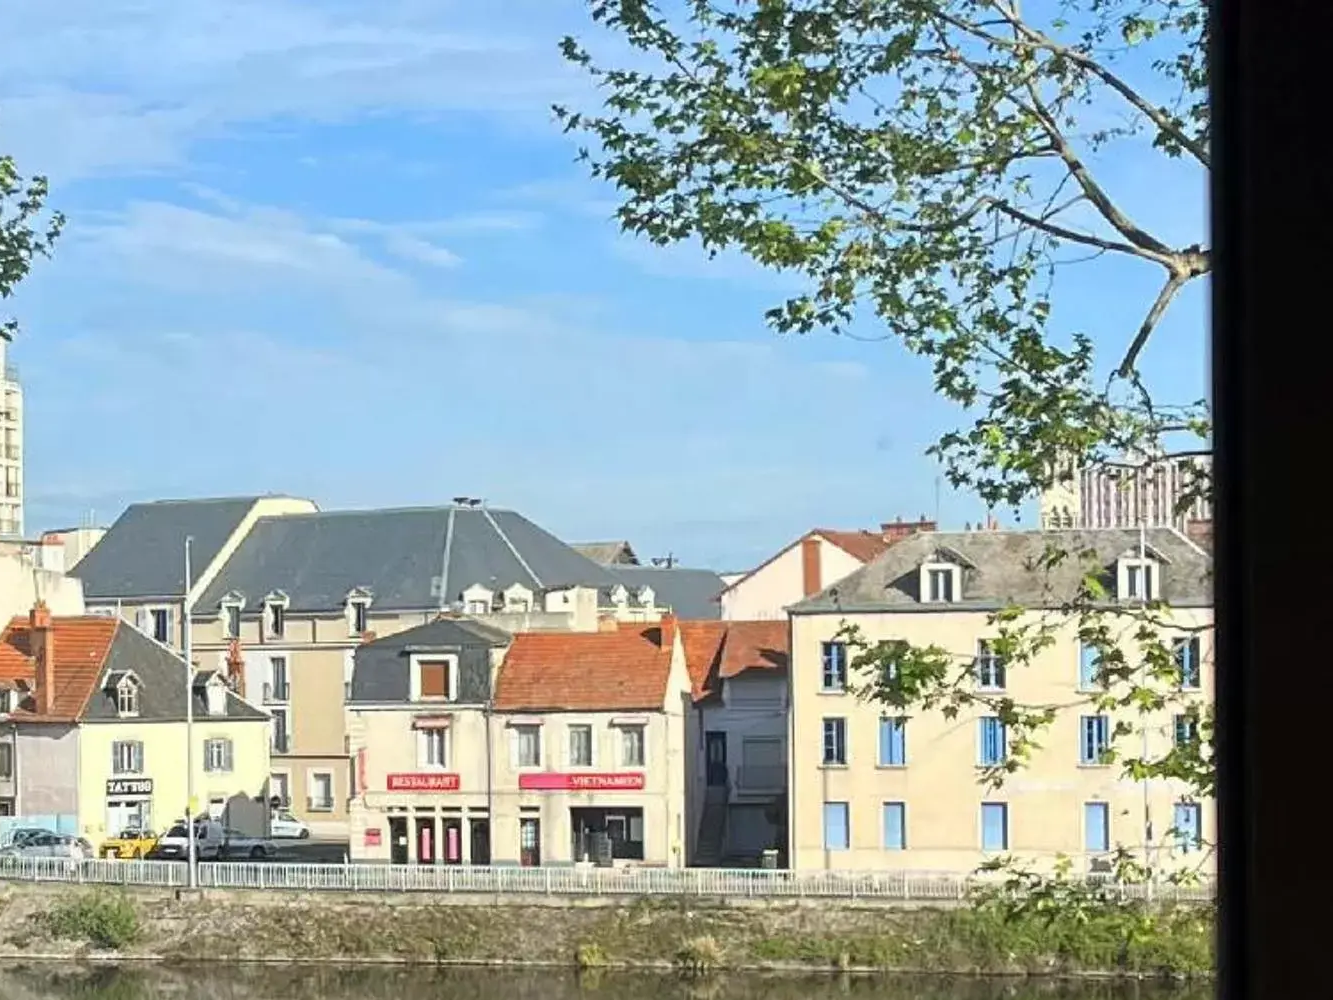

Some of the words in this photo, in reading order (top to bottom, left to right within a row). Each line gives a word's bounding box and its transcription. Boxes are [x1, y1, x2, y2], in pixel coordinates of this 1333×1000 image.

[108, 780, 151, 793] TATTOO
[391, 775, 456, 788] RESTAURANT
[572, 776, 642, 787] VIETNAMIEN
